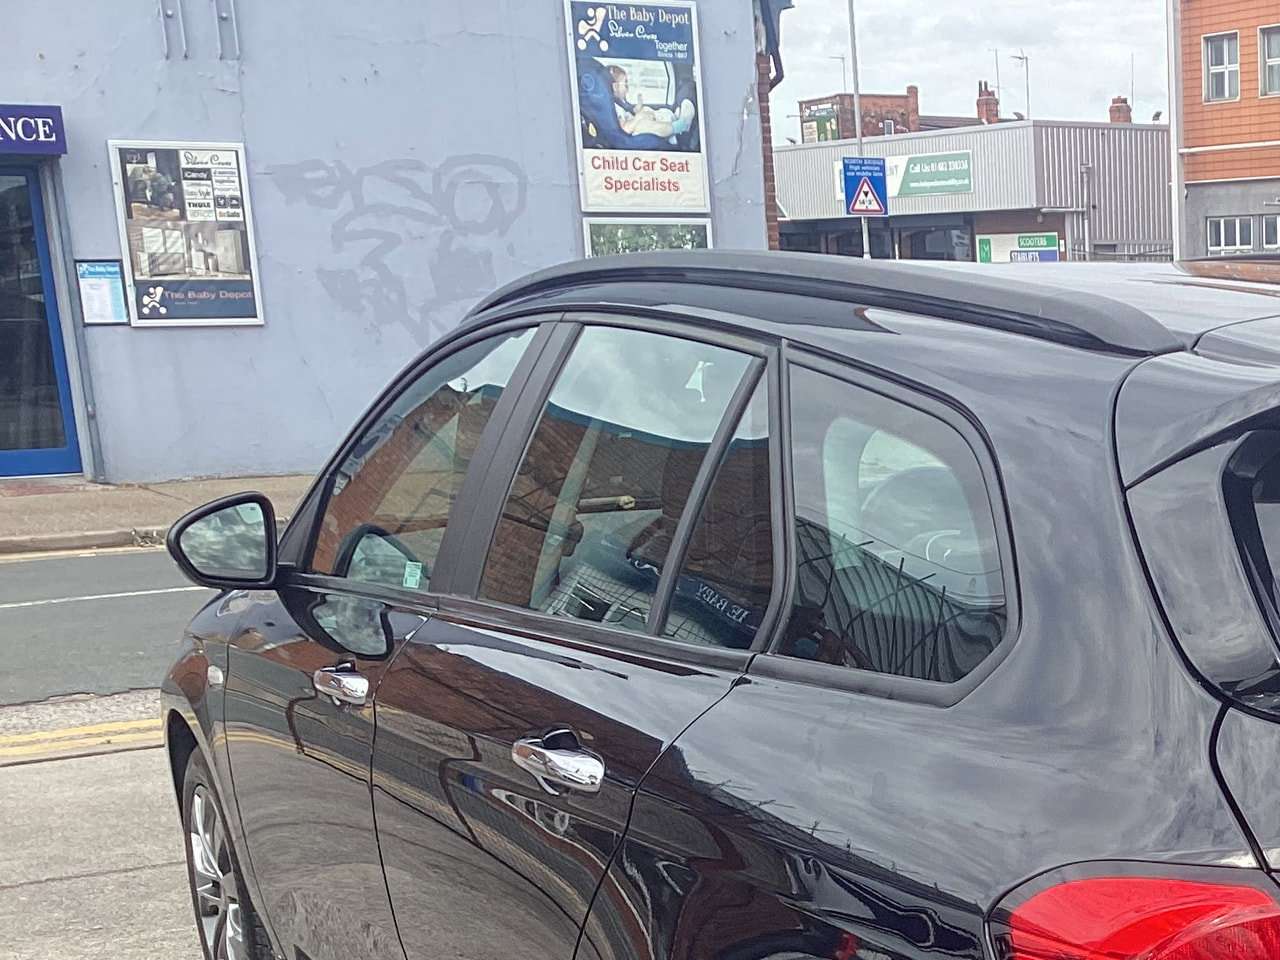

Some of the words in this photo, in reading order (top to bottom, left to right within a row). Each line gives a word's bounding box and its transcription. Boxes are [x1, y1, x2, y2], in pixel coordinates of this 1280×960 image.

[607, 5, 627, 20] The
[629, 7, 655, 26] Baby
[658, 9, 690, 28] Depot
[655, 40, 688, 52] Together
[591, 155, 628, 171] Child
[632, 157, 657, 171] Car
[660, 158, 690, 173] Seat
[604, 176, 680, 192] Specialists
[1019, 237, 1047, 246] SCOOTERS
[164, 288, 185, 299] The
[187, 289, 217, 301] Baby
[219, 289, 253, 300] Depot
